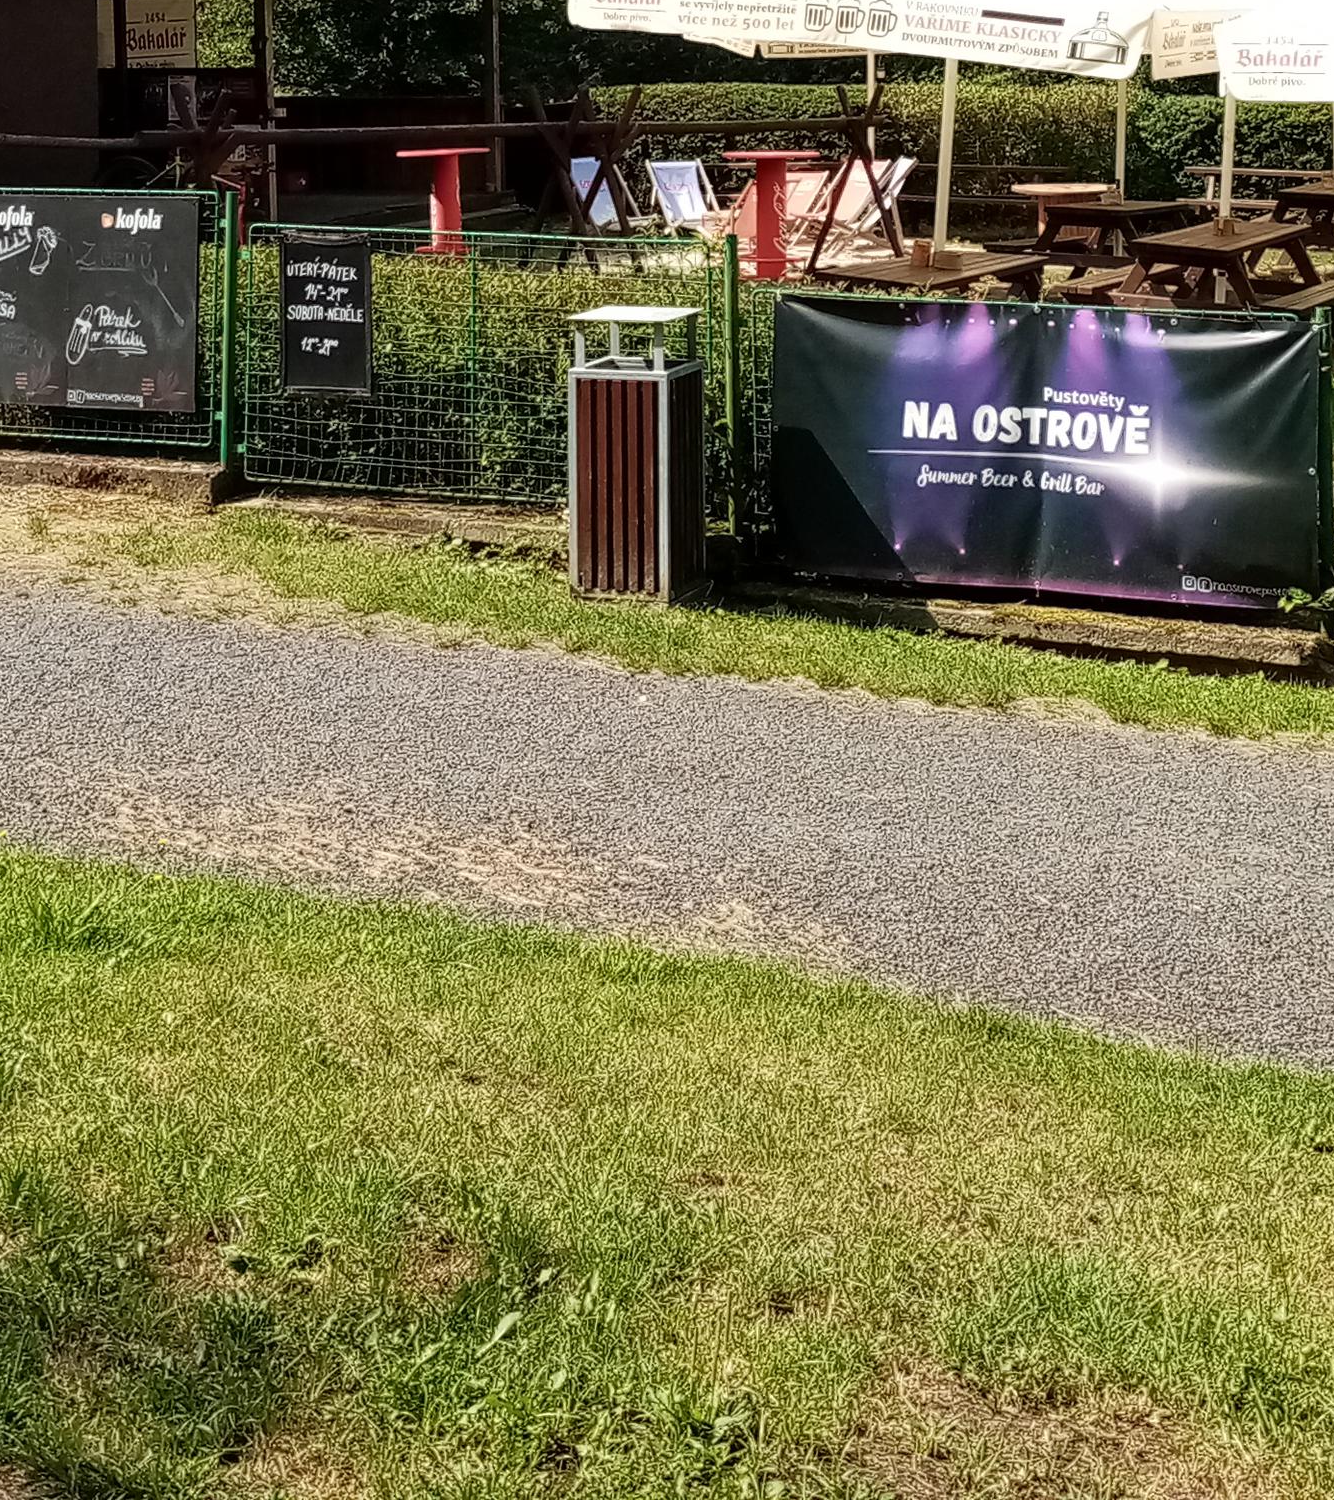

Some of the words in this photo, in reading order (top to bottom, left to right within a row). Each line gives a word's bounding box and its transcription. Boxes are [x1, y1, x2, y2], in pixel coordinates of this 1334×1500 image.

[678, 12, 708, 25] více
[712, 14, 737, 28] než
[743, 18, 771, 30] 500
[776, 17, 794, 30] let
[904, 14, 972, 34] VAŘÍME
[976, 22, 1062, 43] KLASICKY
[126, 26, 187, 51] Bakalář
[998, 41, 1059, 59] ZPŮSOBEM
[1235, 48, 1324, 68] Bakalář
[1248, 76, 1277, 86] Dobré
[114, 206, 162, 235] kofola
[1043, 386, 1125, 412] Pustověty
[902, 400, 958, 441] NA
[972, 404, 1150, 454] OSTROVĚ
[917, 463, 978, 488] Summer
[981, 467, 1018, 488] Beer
[1022, 470, 1035, 488] &
[1040, 470, 1073, 493] Grill
[1074, 475, 1107, 497] Bar
